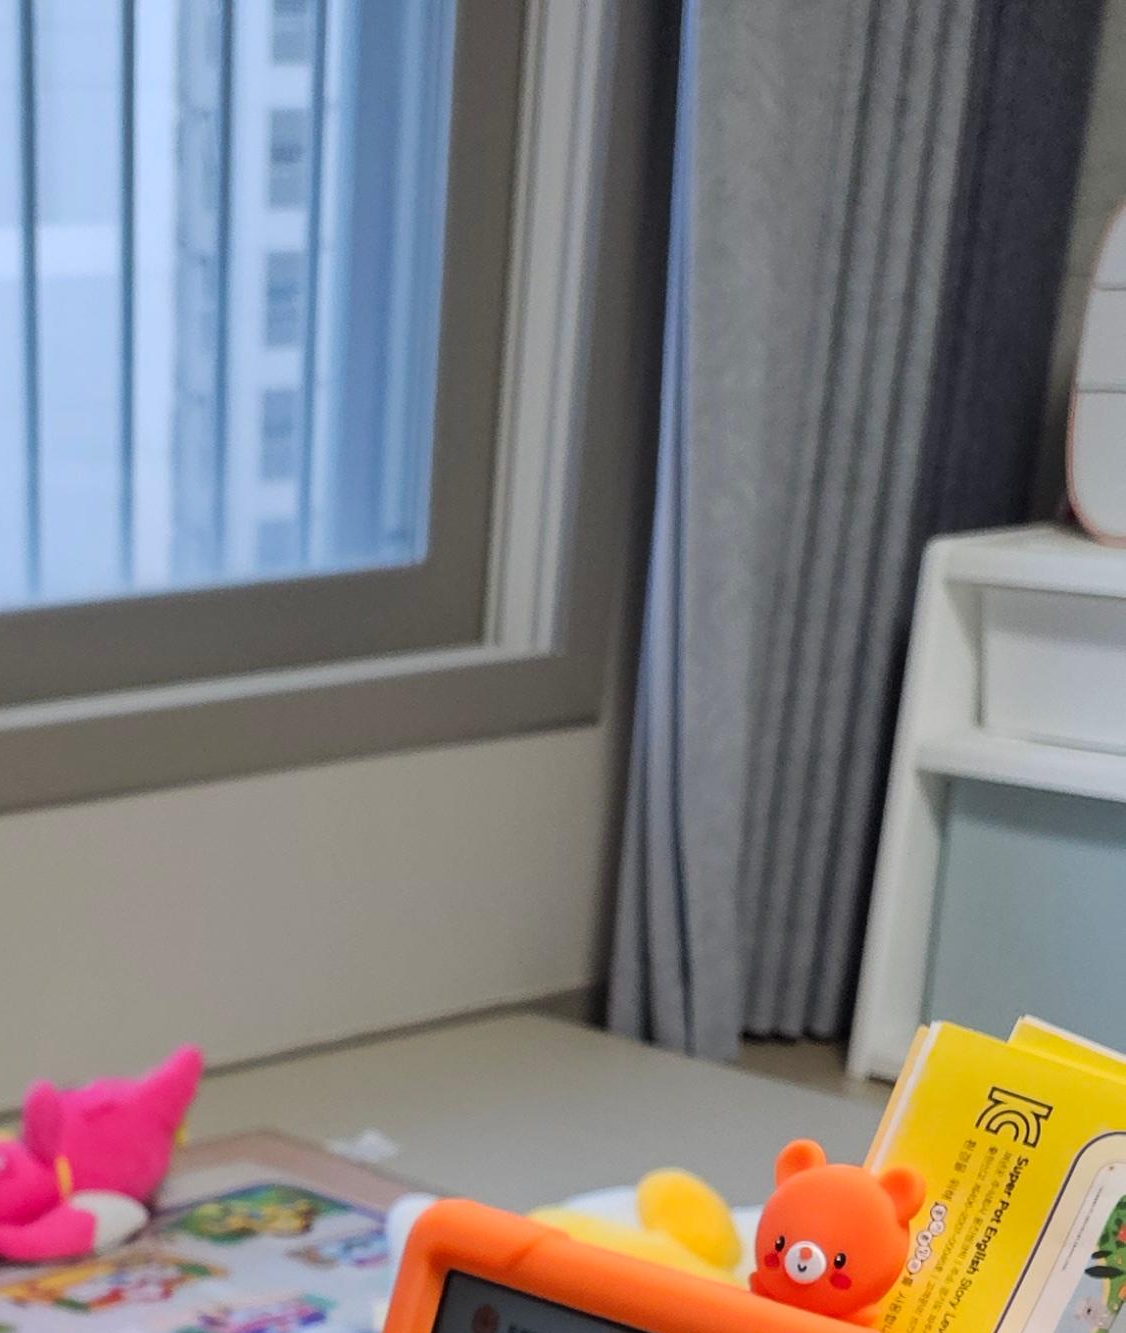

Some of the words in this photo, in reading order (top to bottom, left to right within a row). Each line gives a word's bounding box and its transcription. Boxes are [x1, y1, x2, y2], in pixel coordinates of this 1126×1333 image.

[1004, 1155, 1029, 1198] Super
[990, 1200, 1010, 1224] Pot
[966, 1226, 998, 1275] English
[949, 1277, 972, 1310] Story
